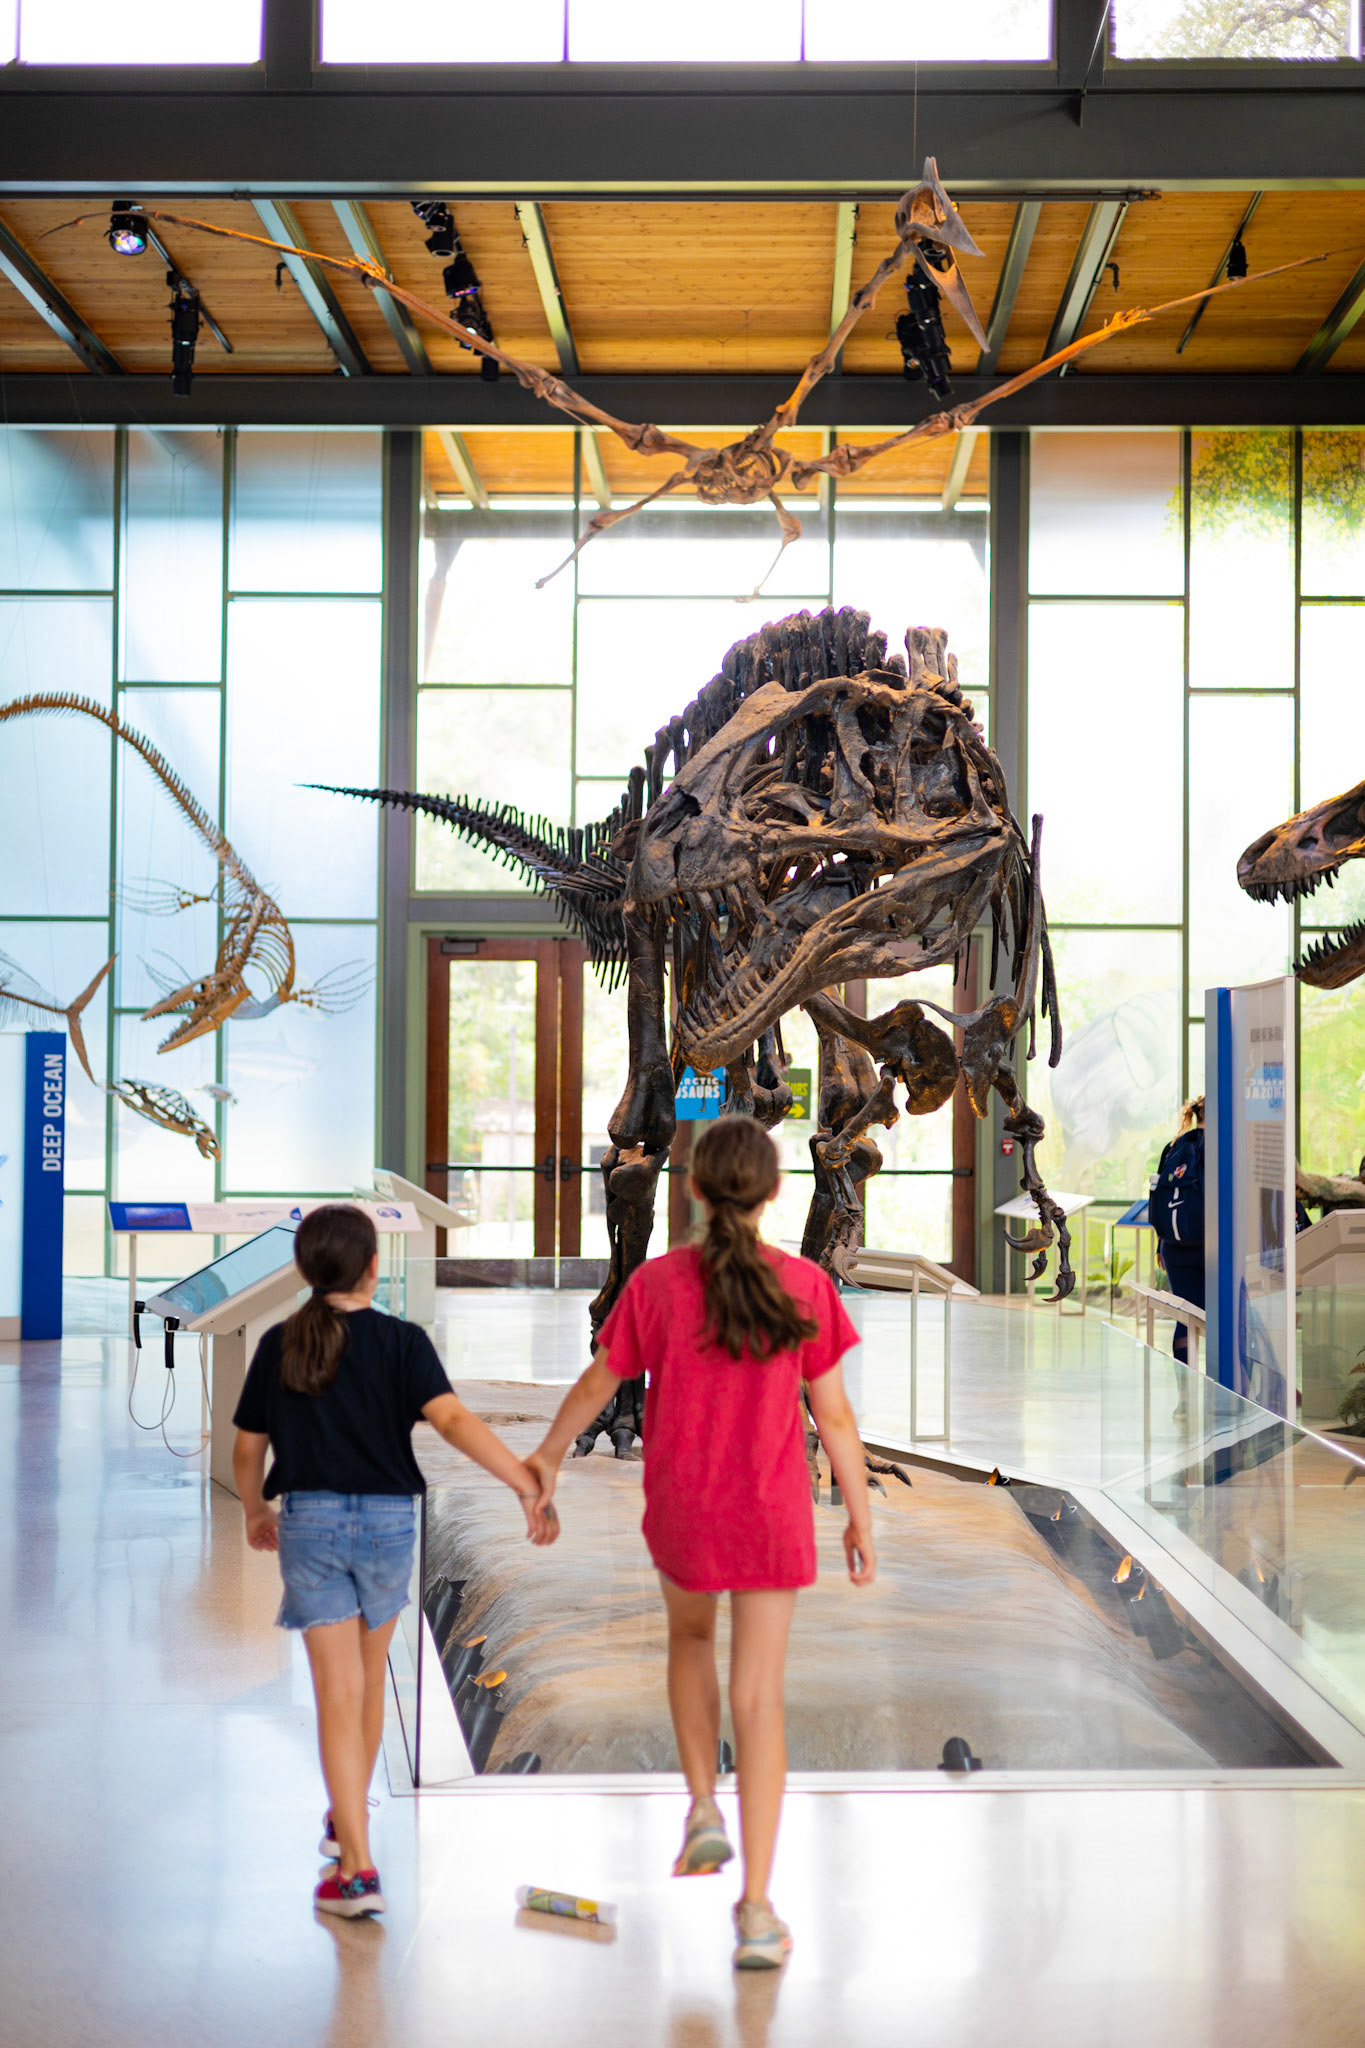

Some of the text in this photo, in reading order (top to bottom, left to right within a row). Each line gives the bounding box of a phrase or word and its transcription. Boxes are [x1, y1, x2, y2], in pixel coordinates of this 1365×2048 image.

[42, 1053, 63, 1172] DEEP OCEAN
[787, 1081, 808, 1096] URS
